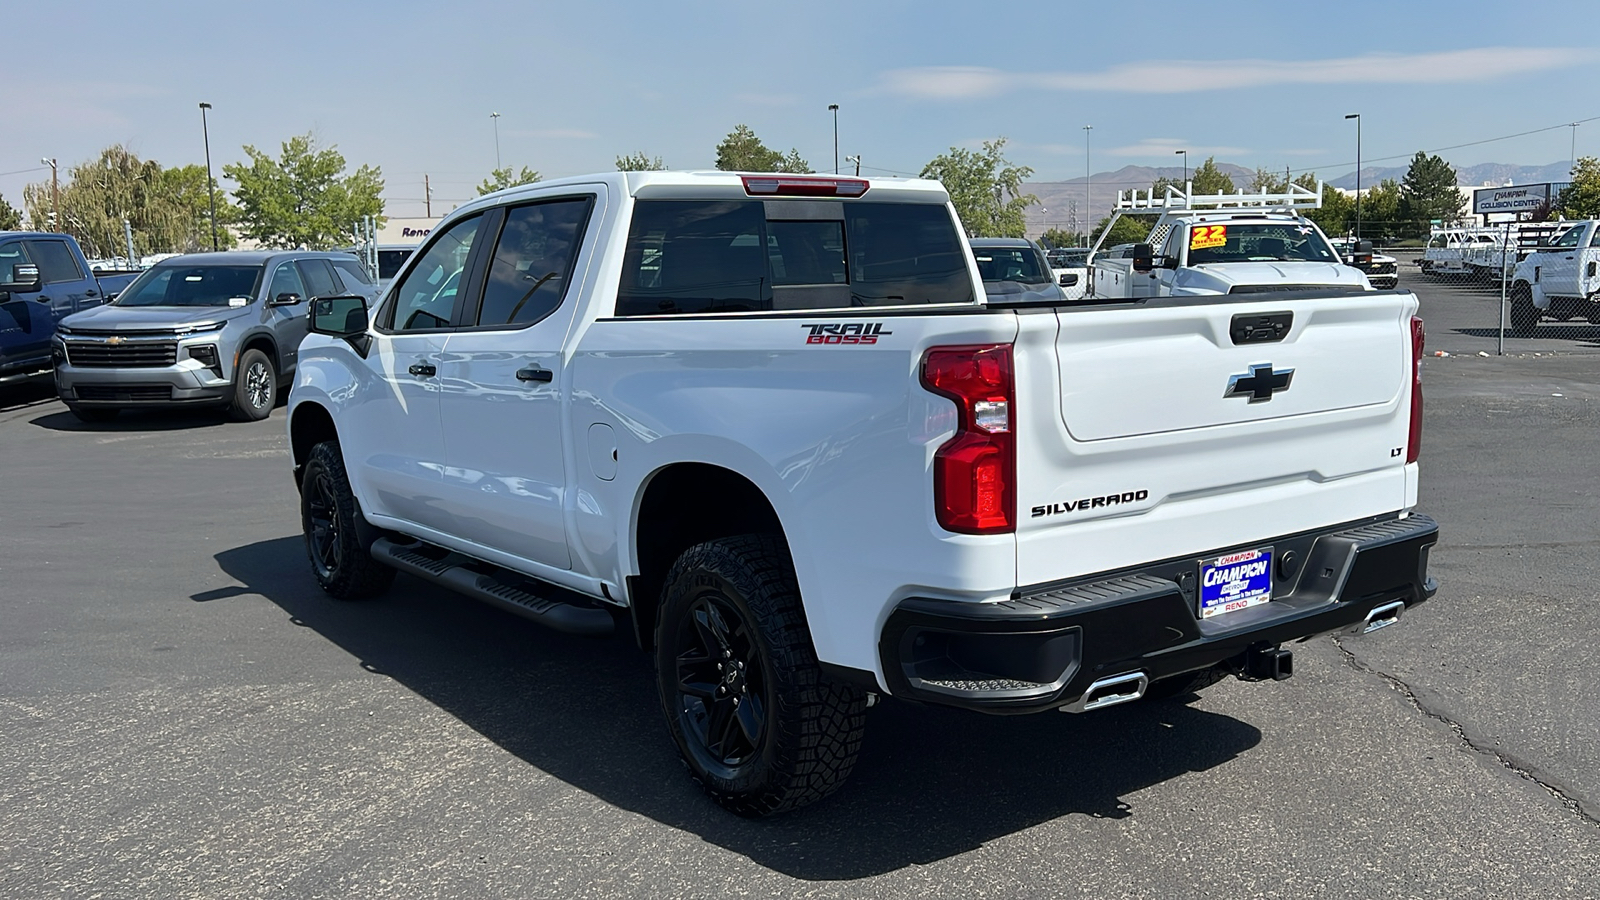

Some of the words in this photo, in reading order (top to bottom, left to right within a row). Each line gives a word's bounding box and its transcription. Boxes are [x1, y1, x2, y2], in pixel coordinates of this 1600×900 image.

[1494, 190, 1527, 201] CHAMPION
[1480, 201, 1512, 209] COLLISION
[1514, 199, 1540, 207] CENTER
[402, 227, 430, 237] Reno
[1193, 226, 1224, 240] 22
[801, 323, 893, 335] TRAIL
[806, 335, 878, 345] BOSS
[1391, 447, 1403, 457] LT
[1031, 490, 1148, 518] SILVERADO
[1220, 552, 1255, 565] CHAMPION
[1203, 560, 1268, 588] CHAMPION
[1225, 600, 1248, 611] RENO
